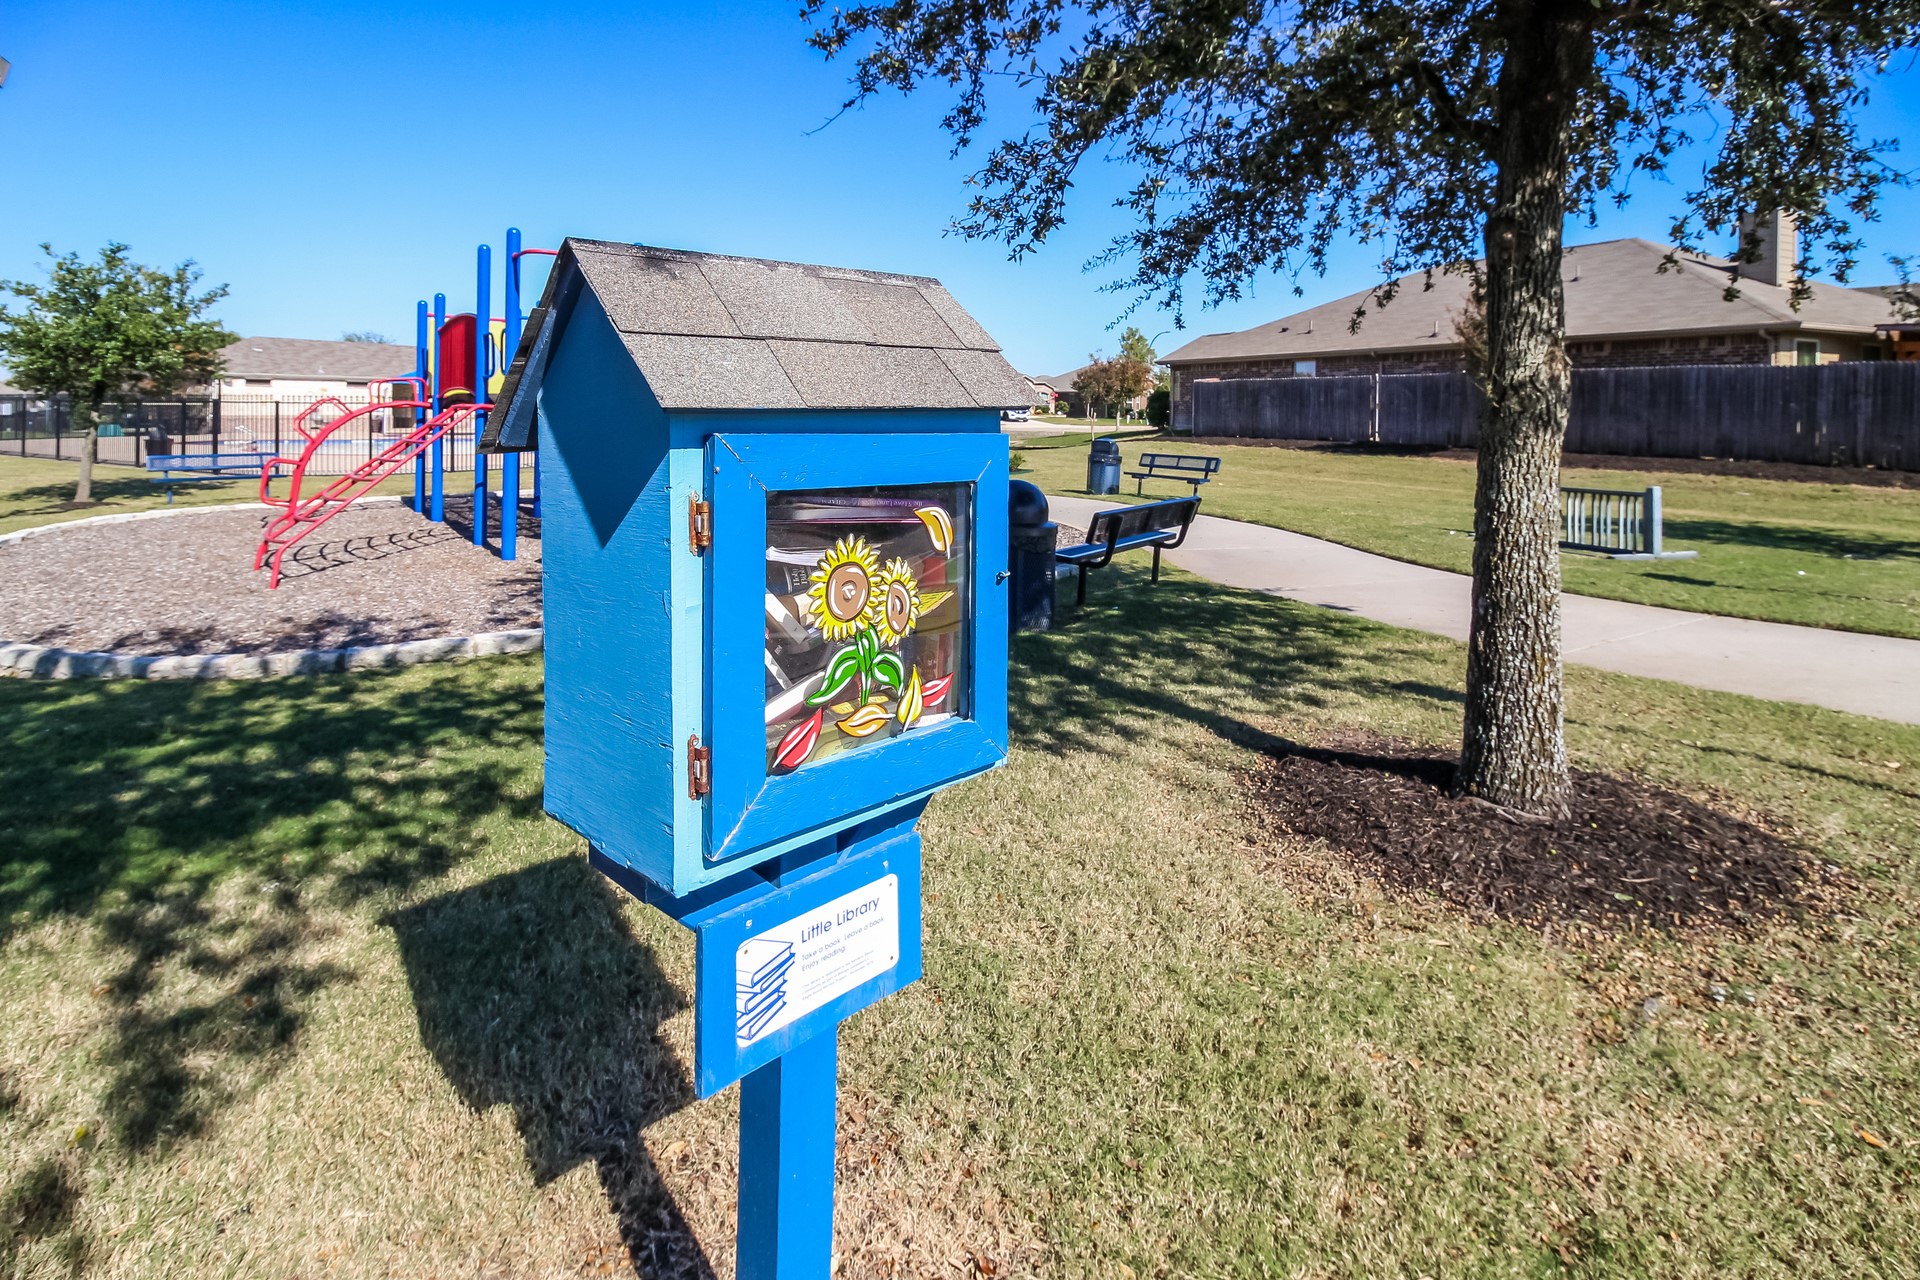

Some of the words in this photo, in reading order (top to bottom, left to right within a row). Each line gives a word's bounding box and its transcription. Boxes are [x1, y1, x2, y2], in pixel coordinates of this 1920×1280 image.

[792, 568, 800, 586] Holy
[801, 920, 832, 943] Little
[836, 897, 880, 926] Library
[801, 949, 817, 961] Take
[801, 958, 820, 972] Enjoy
